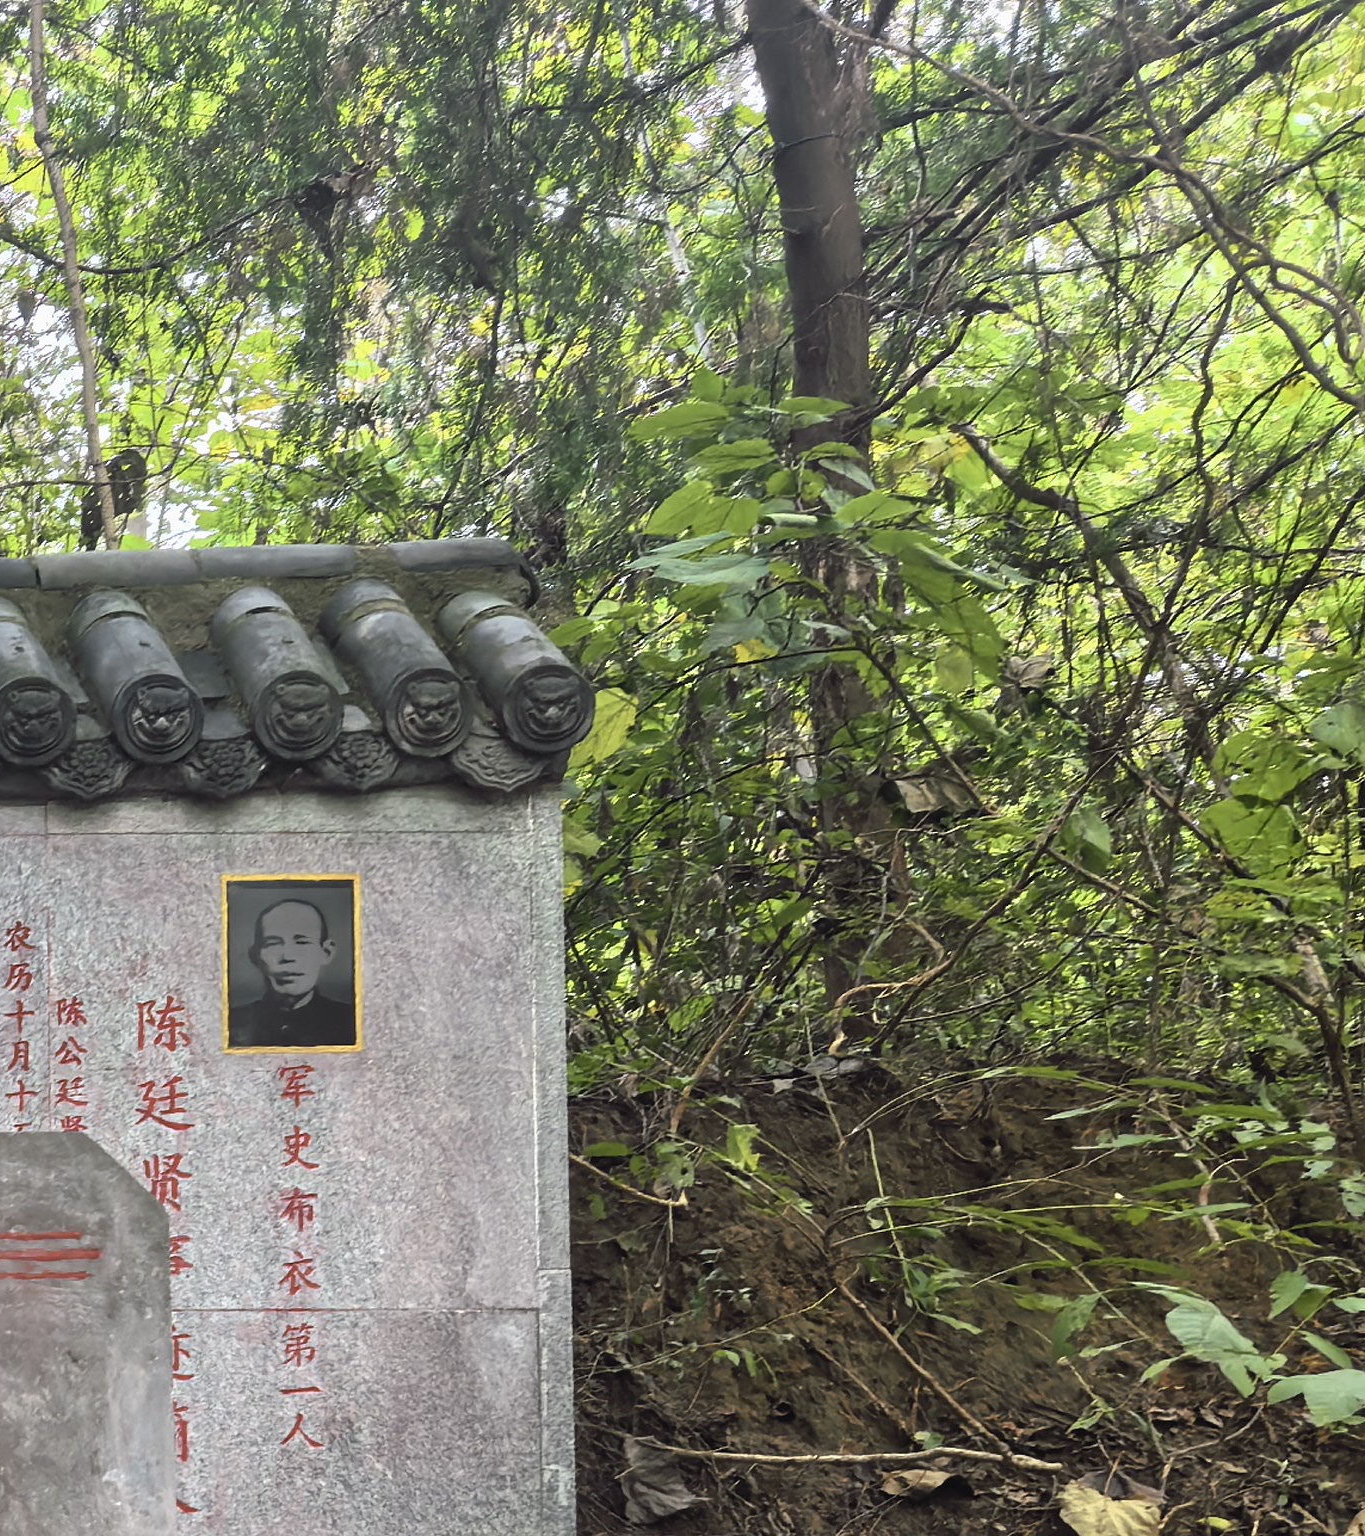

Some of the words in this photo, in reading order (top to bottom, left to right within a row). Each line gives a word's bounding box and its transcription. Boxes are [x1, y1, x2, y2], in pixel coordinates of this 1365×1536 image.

[3, 920, 39, 1132] 农历十月十
[279, 1064, 325, 1450] 军史布衣第一人
